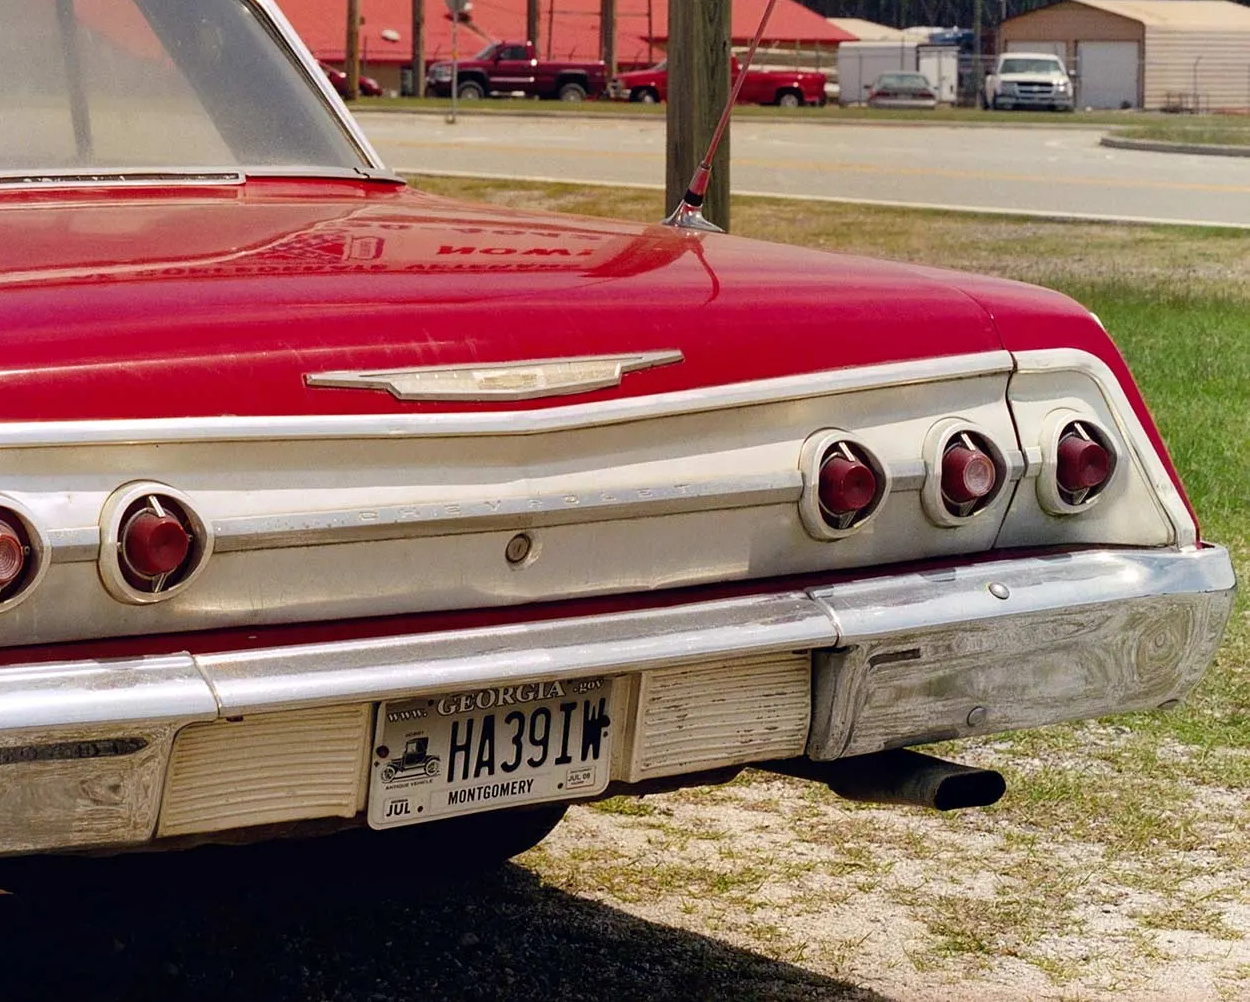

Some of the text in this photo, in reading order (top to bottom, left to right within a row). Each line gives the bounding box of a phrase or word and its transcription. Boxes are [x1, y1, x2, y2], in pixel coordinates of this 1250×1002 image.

[436, 679, 567, 717] GEORGIA
[446, 697, 608, 783] HA39IW
[447, 778, 535, 806] MONTGOMERY
[385, 801, 411, 817] JUL
